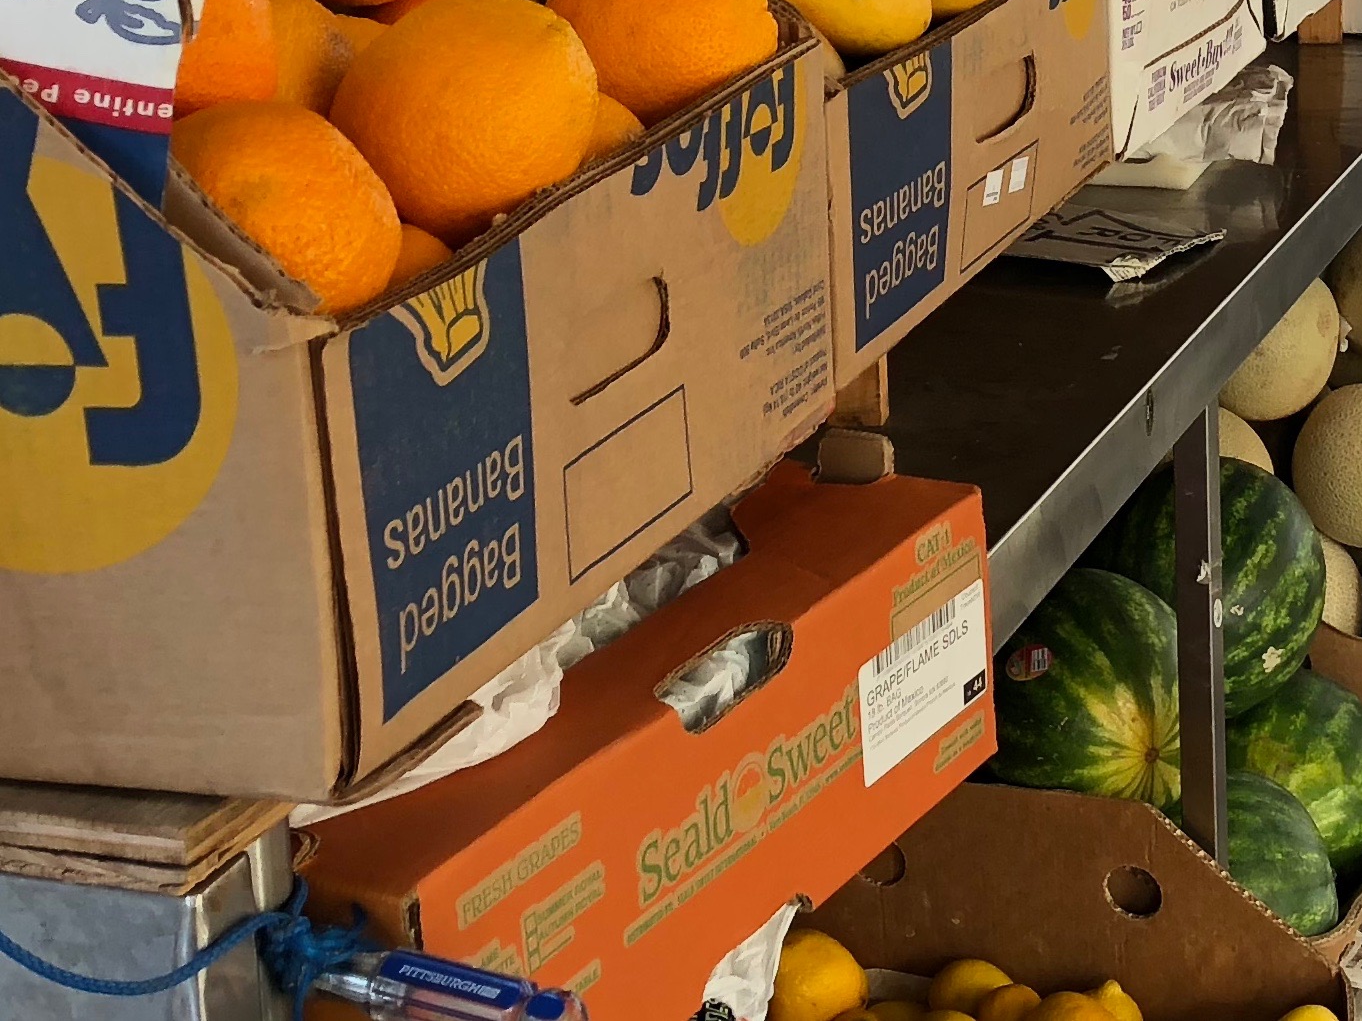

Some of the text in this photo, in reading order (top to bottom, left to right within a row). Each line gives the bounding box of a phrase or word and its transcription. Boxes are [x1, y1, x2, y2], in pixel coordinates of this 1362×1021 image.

[74, 87, 174, 120] entine
[859, 160, 947, 245] Bananas
[864, 223, 940, 320] Bagged
[383, 433, 526, 570] Bananas
[399, 521, 521, 676] Bagged
[866, 619, 969, 707] GRAPE/FLAME SDLS
[886, 687, 902, 706] BAG
[972, 678, 983, 691] 44
[640, 778, 734, 905] Seald
[766, 696, 857, 805] Sweet
[461, 819, 579, 925] FRESH GRAPES
[399, 964, 482, 995] PITTSBURGH
